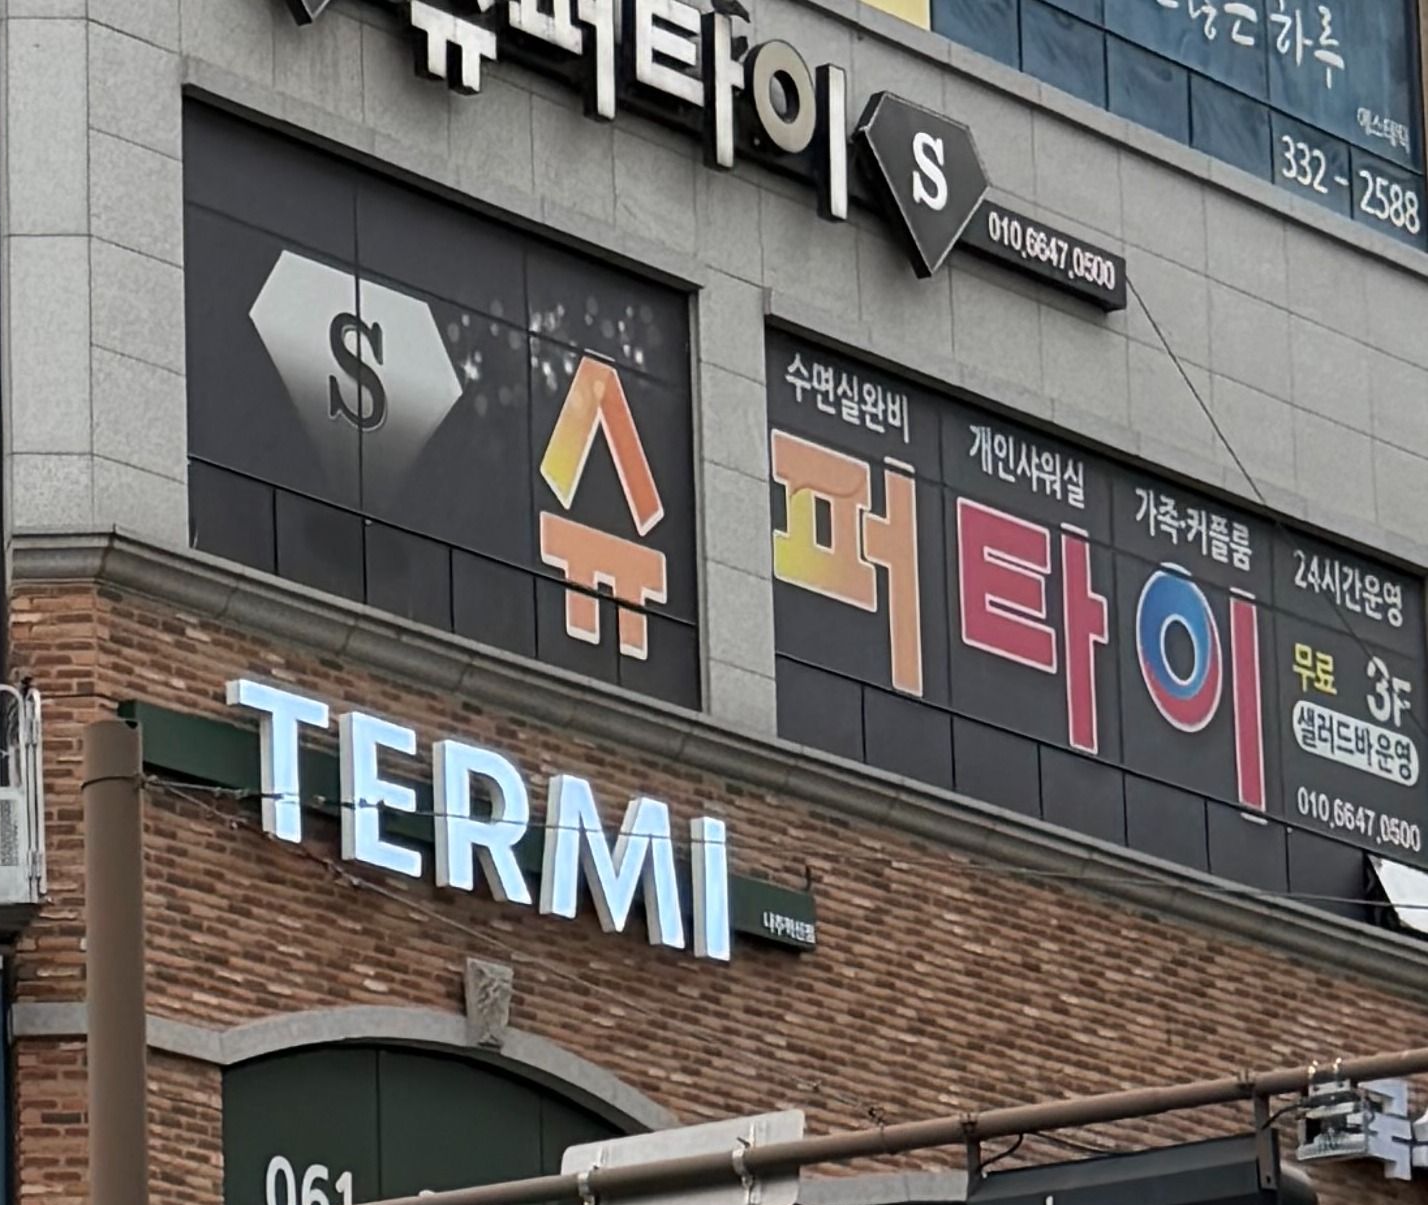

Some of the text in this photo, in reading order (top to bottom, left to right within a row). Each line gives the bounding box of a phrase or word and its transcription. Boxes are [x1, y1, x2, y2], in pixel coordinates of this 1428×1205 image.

[912, 131, 1115, 291] S 010.6647.0500
[326, 311, 386, 431] S
[785, 352, 910, 443] 수면실완비
[968, 423, 1087, 510] 개인샤워실
[1294, 550, 1404, 628] 24시간운영
[1293, 642, 1338, 695] 무료
[1366, 655, 1412, 727] 3F
[226, 678, 731, 961] TERMI
